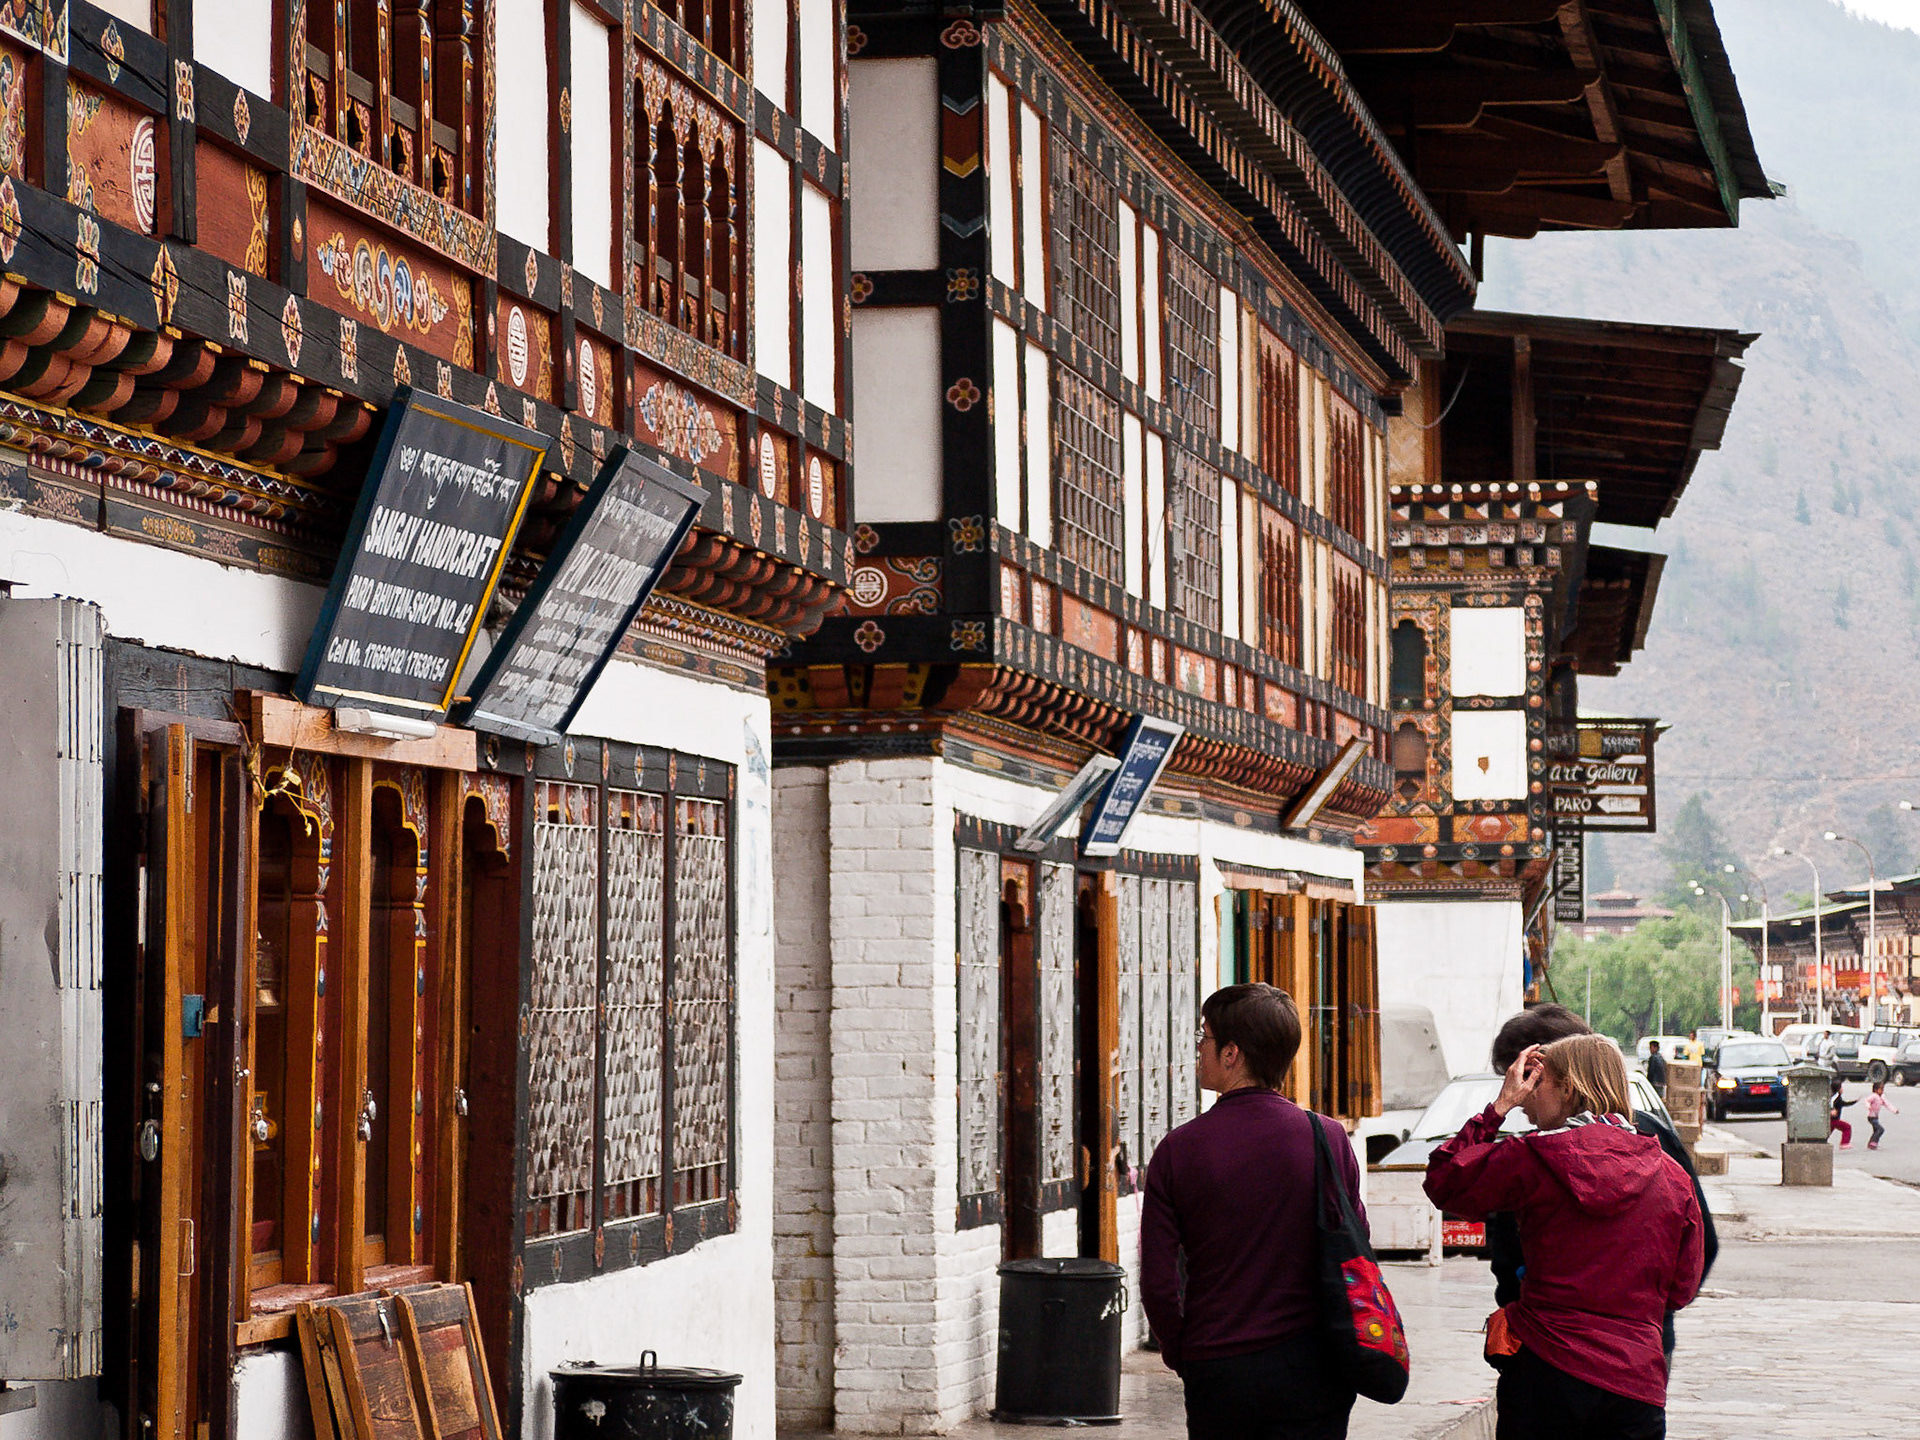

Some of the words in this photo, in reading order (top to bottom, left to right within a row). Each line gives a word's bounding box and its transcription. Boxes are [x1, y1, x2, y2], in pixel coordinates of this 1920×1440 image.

[365, 505, 422, 561] SANGAY
[411, 520, 502, 580] HANDICRAFT
[344, 575, 375, 611] PARO
[327, 636, 350, 663] Cell
[346, 640, 361, 666] No.
[1555, 796, 1592, 811] PARO
